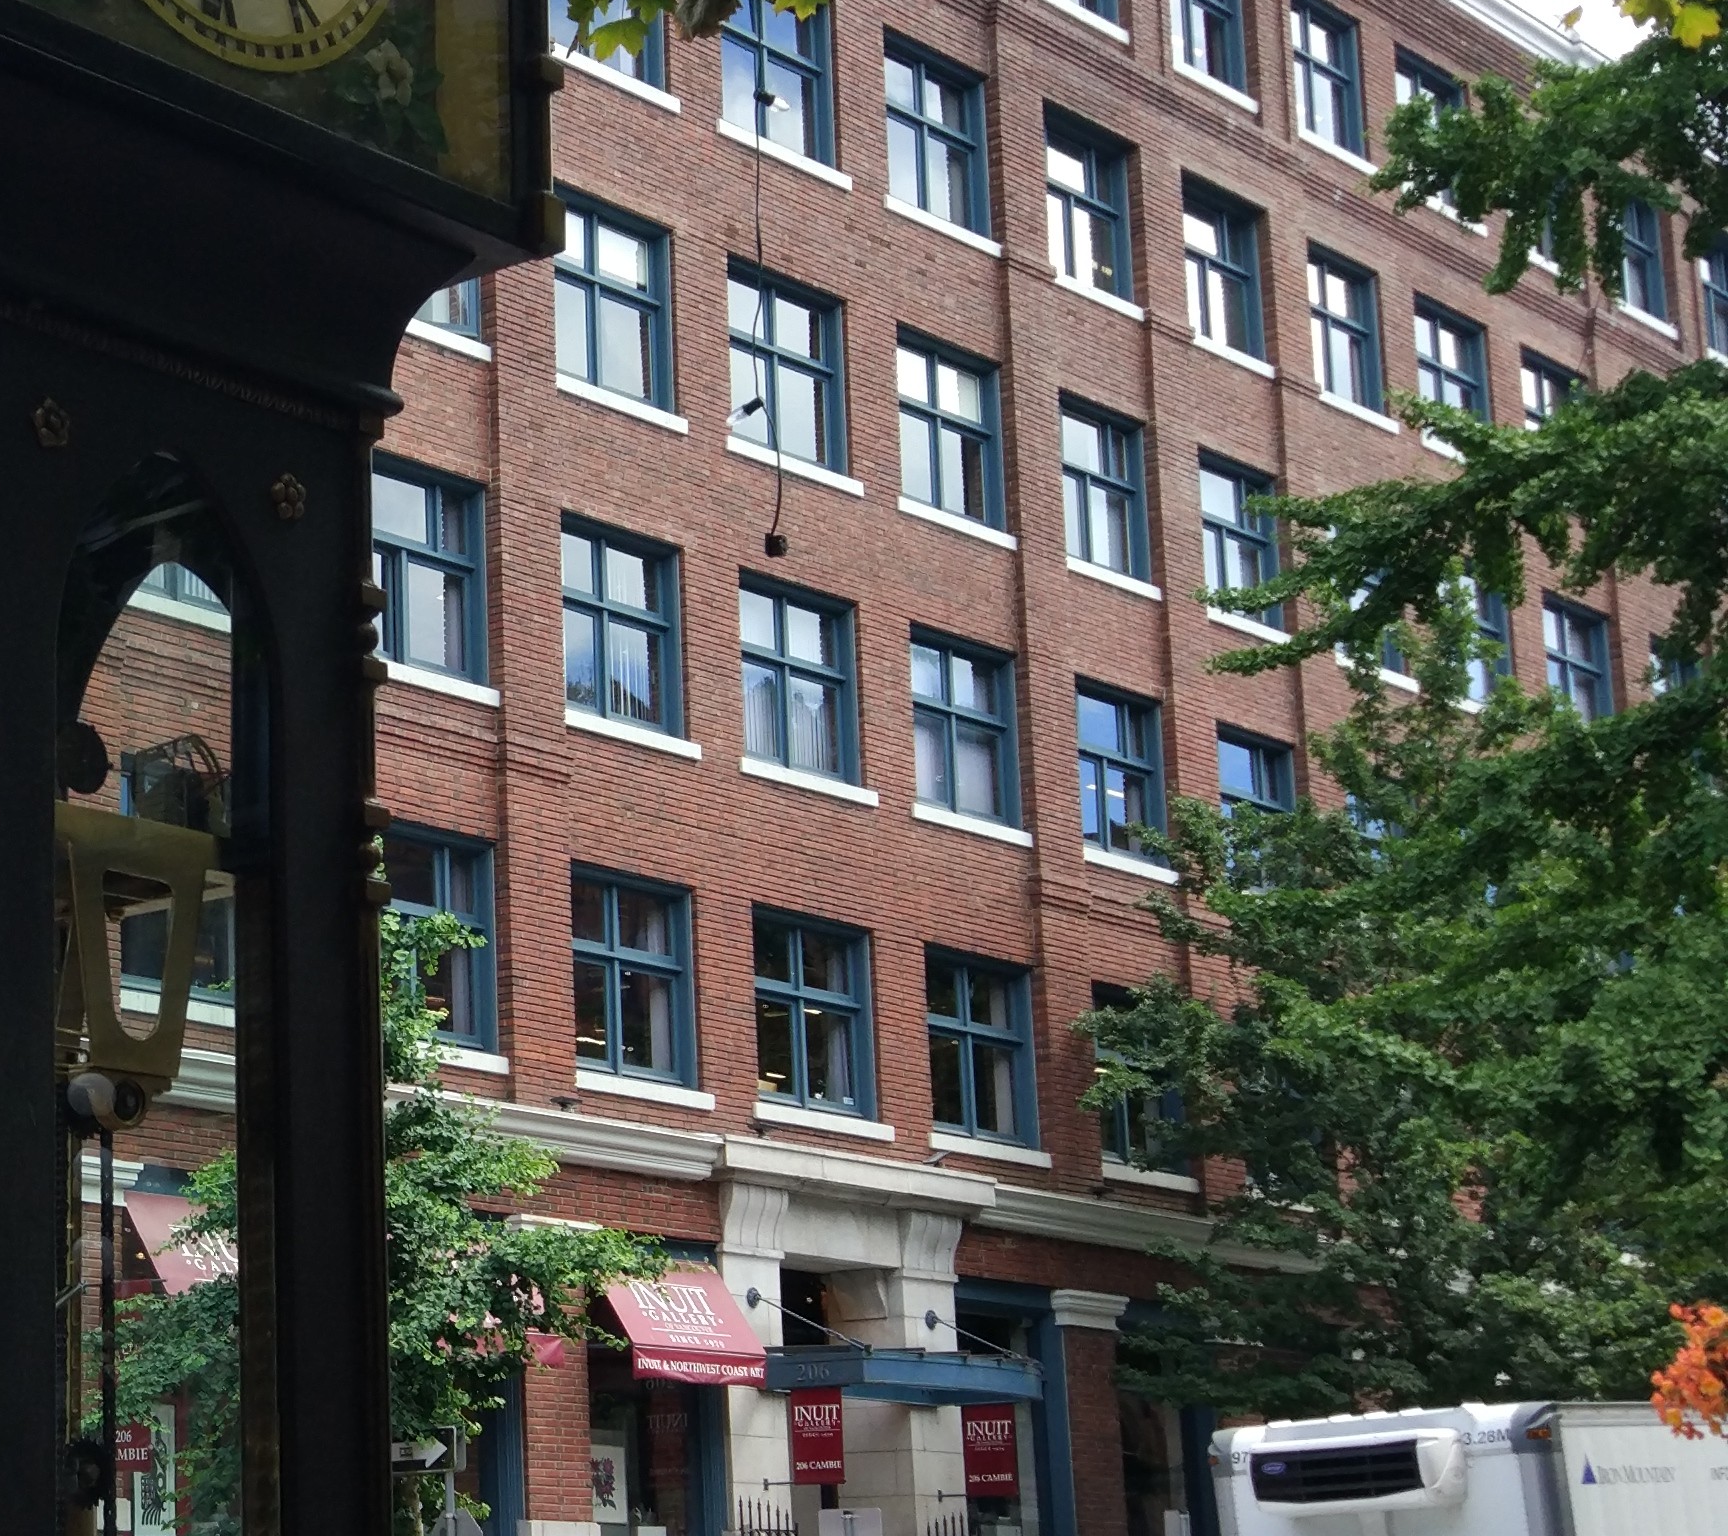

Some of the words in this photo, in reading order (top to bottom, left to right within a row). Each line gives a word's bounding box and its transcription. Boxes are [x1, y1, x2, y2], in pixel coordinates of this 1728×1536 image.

[628, 1280, 715, 1316] INUIT
[648, 1310, 717, 1327] GALLERY
[669, 1334, 701, 1345] SINCE
[670, 1361, 720, 1376] NORTHWEST
[722, 1364, 748, 1377] COAST
[750, 1366, 764, 1379] ART
[797, 1364, 830, 1381] 206
[794, 1404, 840, 1421] INUIT
[967, 1420, 1011, 1436] INUIT
[115, 1430, 132, 1444] 206
[115, 1447, 149, 1462] MBIE
[809, 1460, 842, 1470] CAMBIE
[981, 1473, 1013, 1482] CAMBIE
